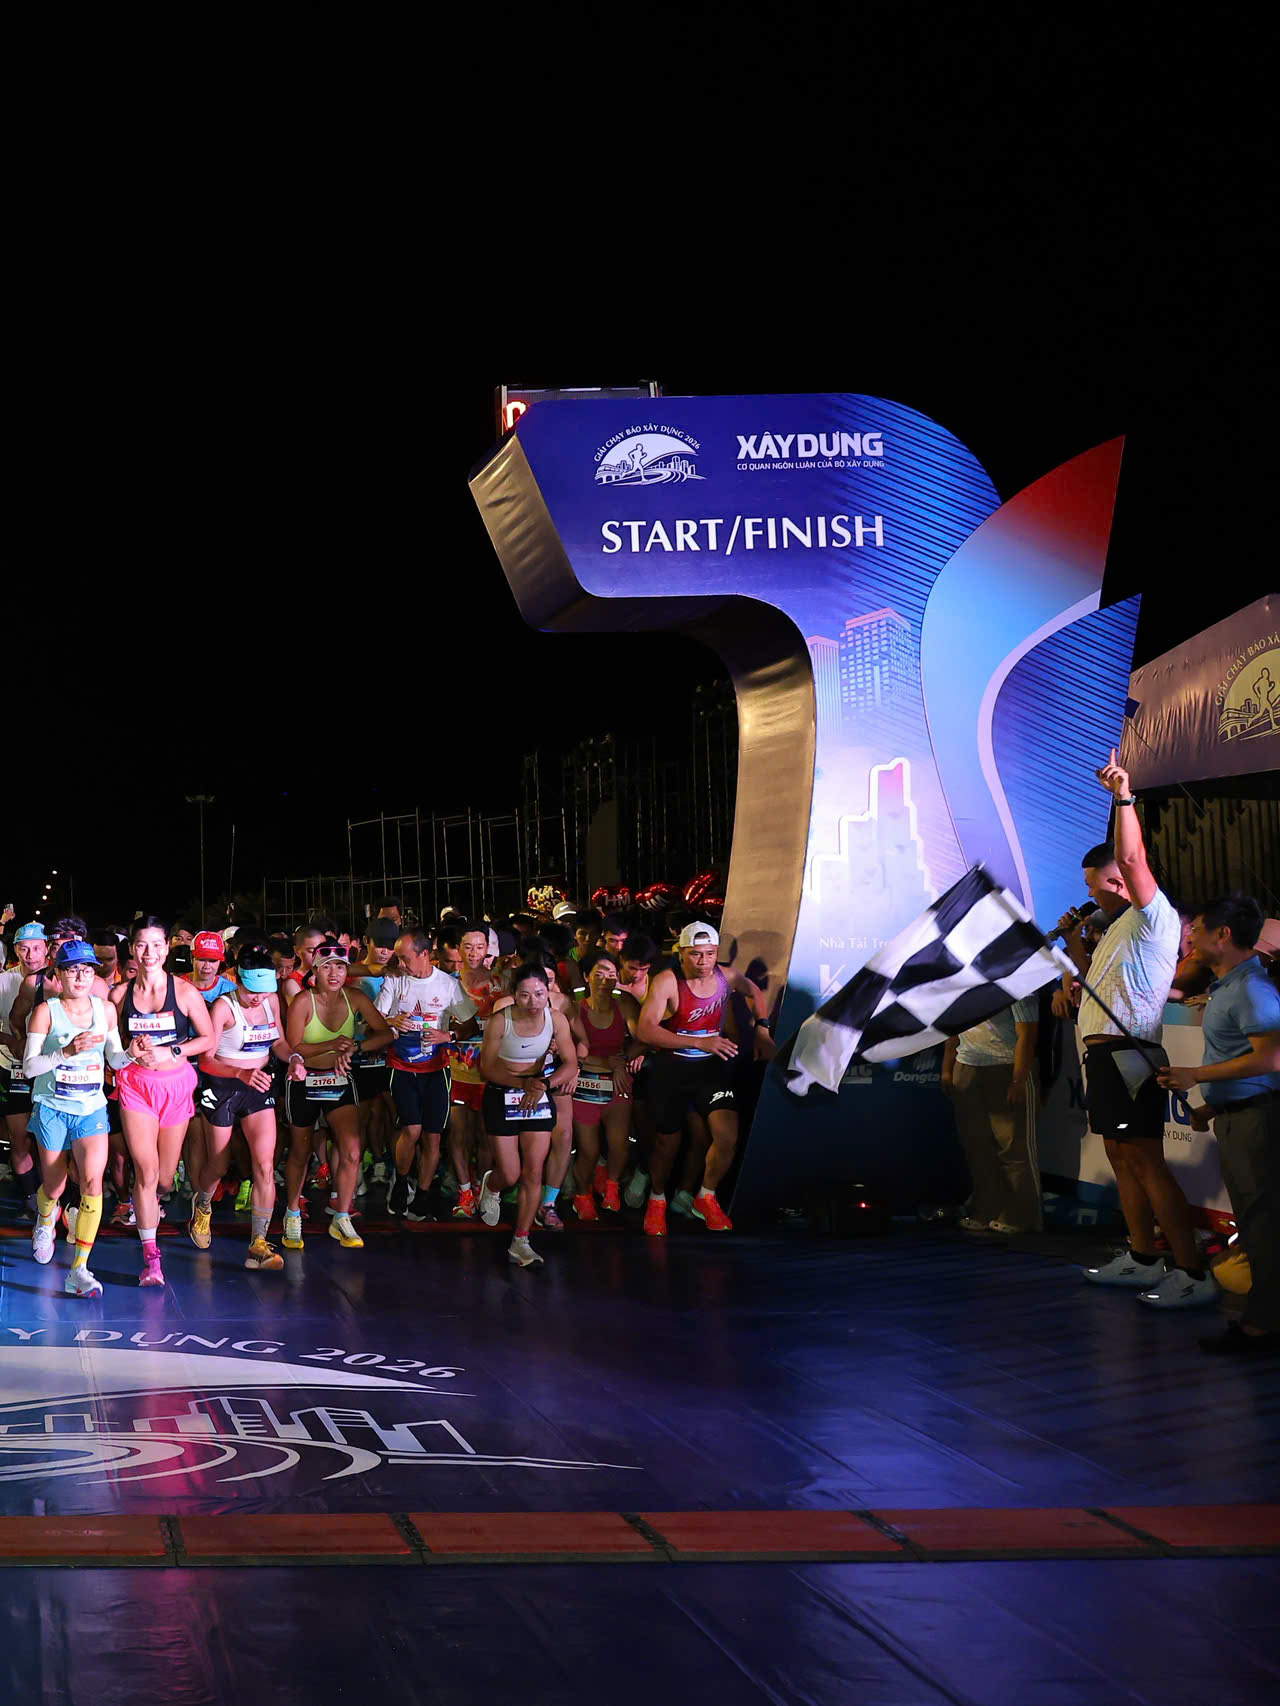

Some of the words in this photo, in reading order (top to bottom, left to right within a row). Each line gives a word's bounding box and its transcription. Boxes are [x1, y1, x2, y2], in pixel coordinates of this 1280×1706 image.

[684, 435, 701, 450] 2026
[749, 462, 771, 471] QUAN
[772, 461, 794, 470] NGÔN
[601, 514, 885, 555] START/FINISH
[1267, 632, 1280, 645] XÂ
[133, 1022, 161, 1030] 21644
[312, 1078, 337, 1086] 21761
[893, 1071, 940, 1084] Dongta
[577, 1080, 601, 1089] 21556
[72, 1329, 287, 1354] DỰNG
[299, 1347, 466, 1379] 2026
